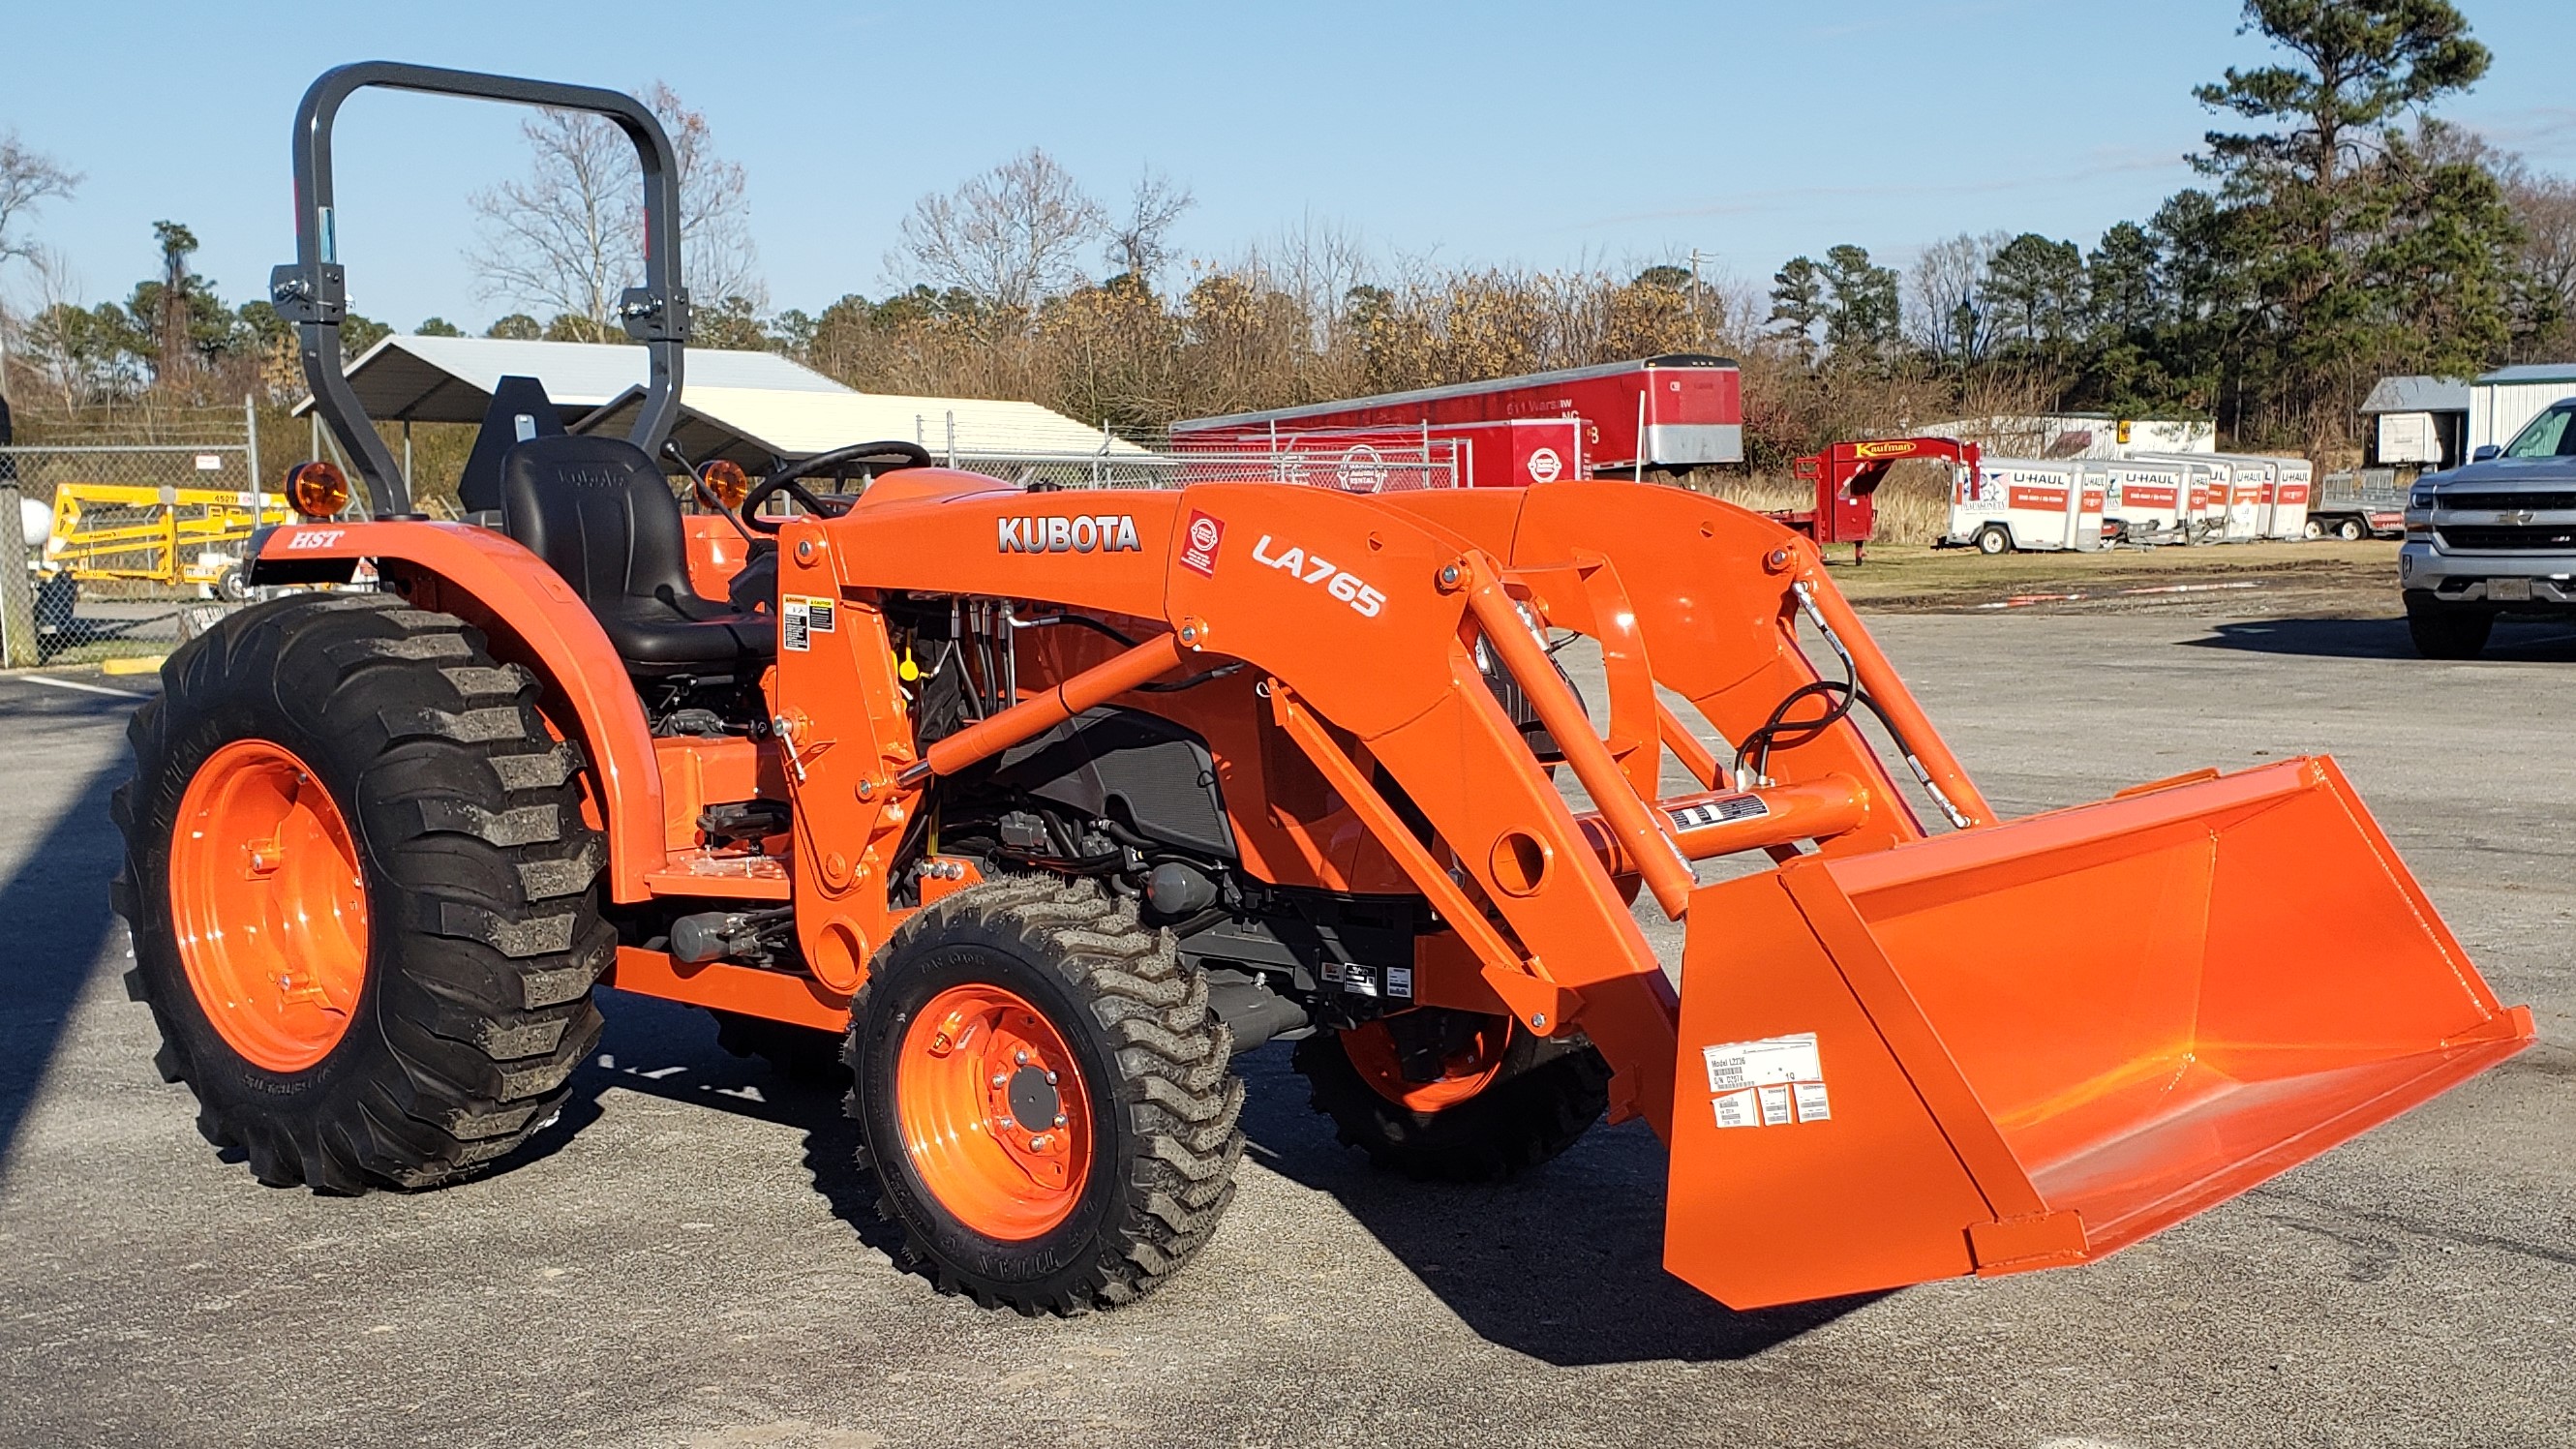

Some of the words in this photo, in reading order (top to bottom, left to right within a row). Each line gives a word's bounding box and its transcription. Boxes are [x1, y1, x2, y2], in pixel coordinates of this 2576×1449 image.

[1854, 442, 1911, 458] Kaufman
[288, 530, 346, 550] HST
[997, 514, 1142, 554] KUBOTA
[1252, 533, 1387, 619] LA765
[1712, 1059, 1728, 1068] Model
